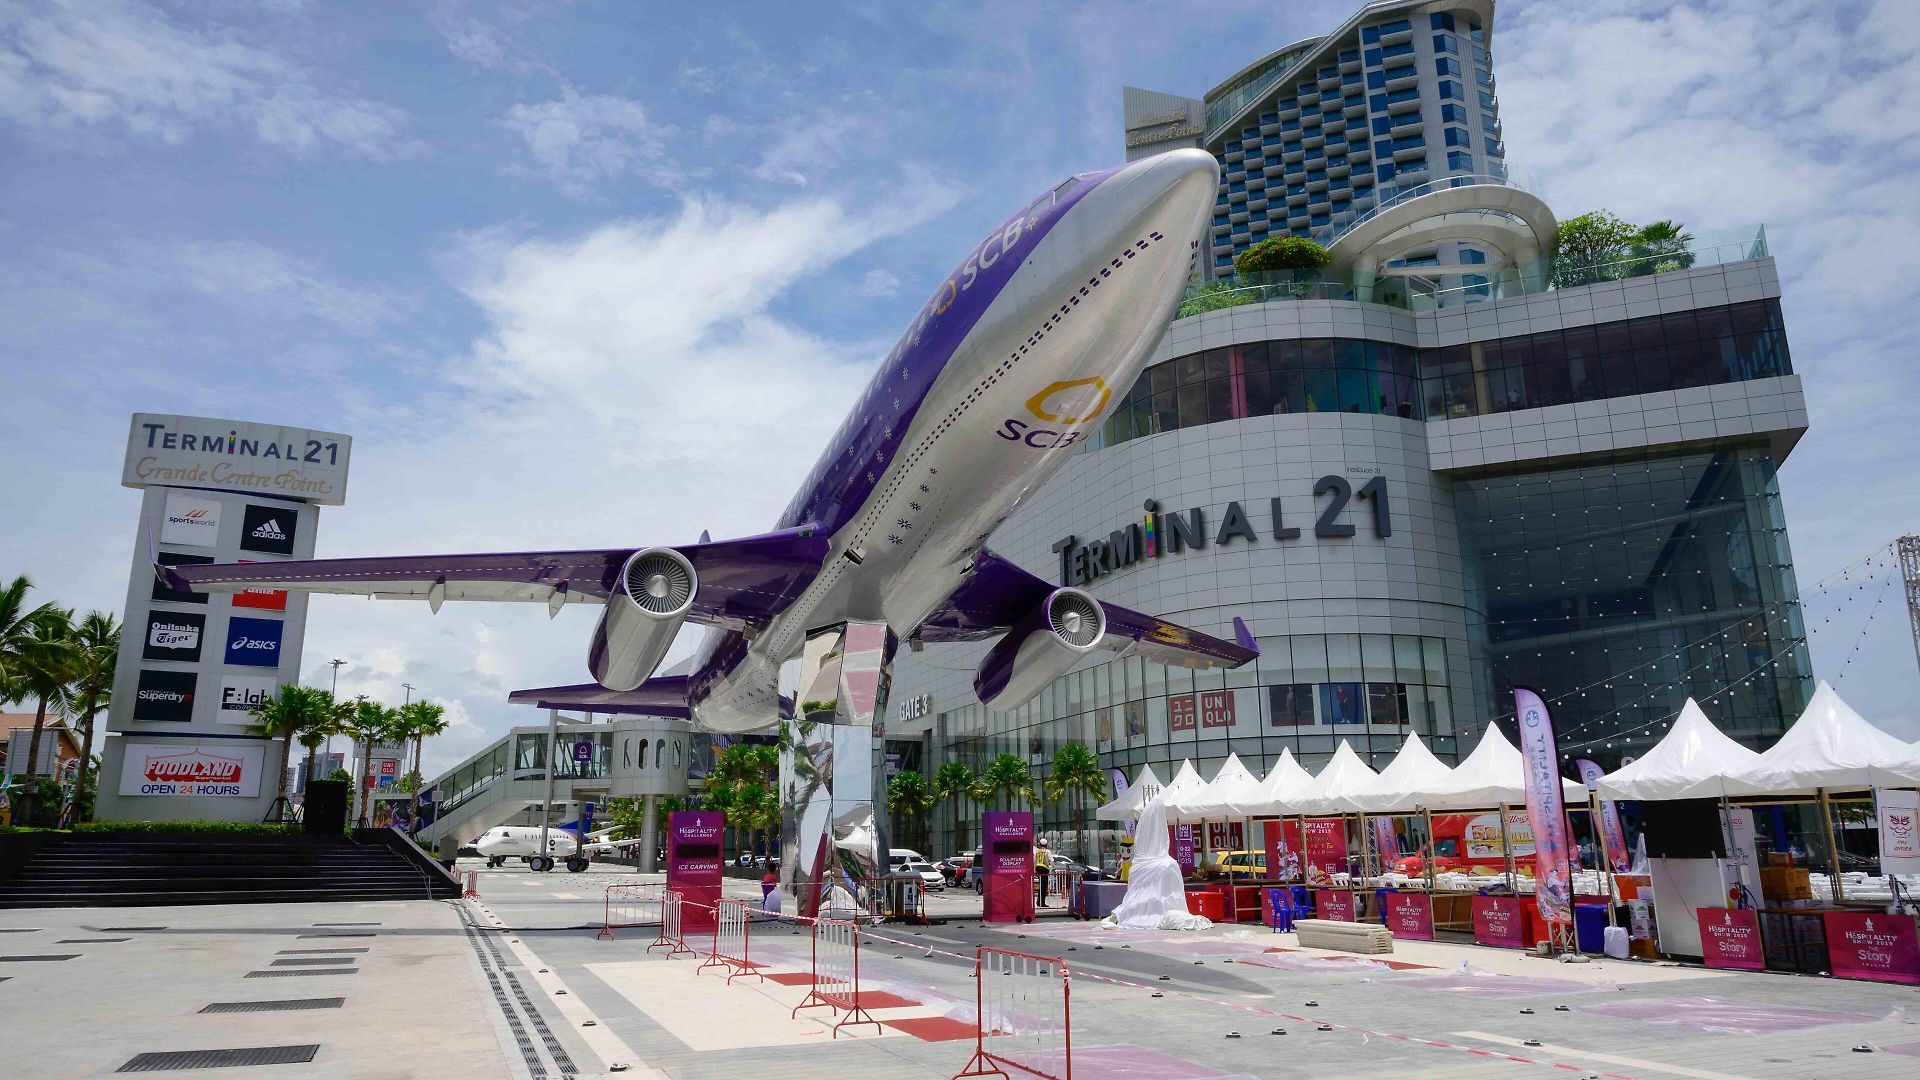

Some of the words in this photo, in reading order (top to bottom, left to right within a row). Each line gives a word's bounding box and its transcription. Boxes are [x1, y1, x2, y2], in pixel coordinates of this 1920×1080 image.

[962, 217, 1025, 291] SCB
[996, 419, 1080, 449] SCB
[135, 456, 207, 482] Grande
[210, 462, 271, 487] Centre
[275, 469, 332, 494] Point
[169, 516, 215, 527] sportsworld
[252, 530, 286, 540] adidas
[152, 622, 199, 633] Onitsuka
[156, 632, 189, 644] Tiger
[246, 639, 276, 650] asics
[139, 690, 185, 703] Superdry
[900, 695, 920, 720] GATE
[922, 694, 928, 714] 3
[145, 760, 237, 777] FOODLAND
[141, 784, 176, 794] OPEN
[180, 785, 193, 794] 24
[197, 785, 240, 795] HOURS
[1295, 821, 1336, 829] HSPITALITY
[1402, 918, 1419, 928] Story
[1489, 923, 1507, 933] Story
[1708, 925, 1751, 934] HOSPITALITY
[1845, 931, 1898, 941] HOSPITALITY
[1719, 941, 1746, 954] Story
[1858, 949, 1891, 964] Story
